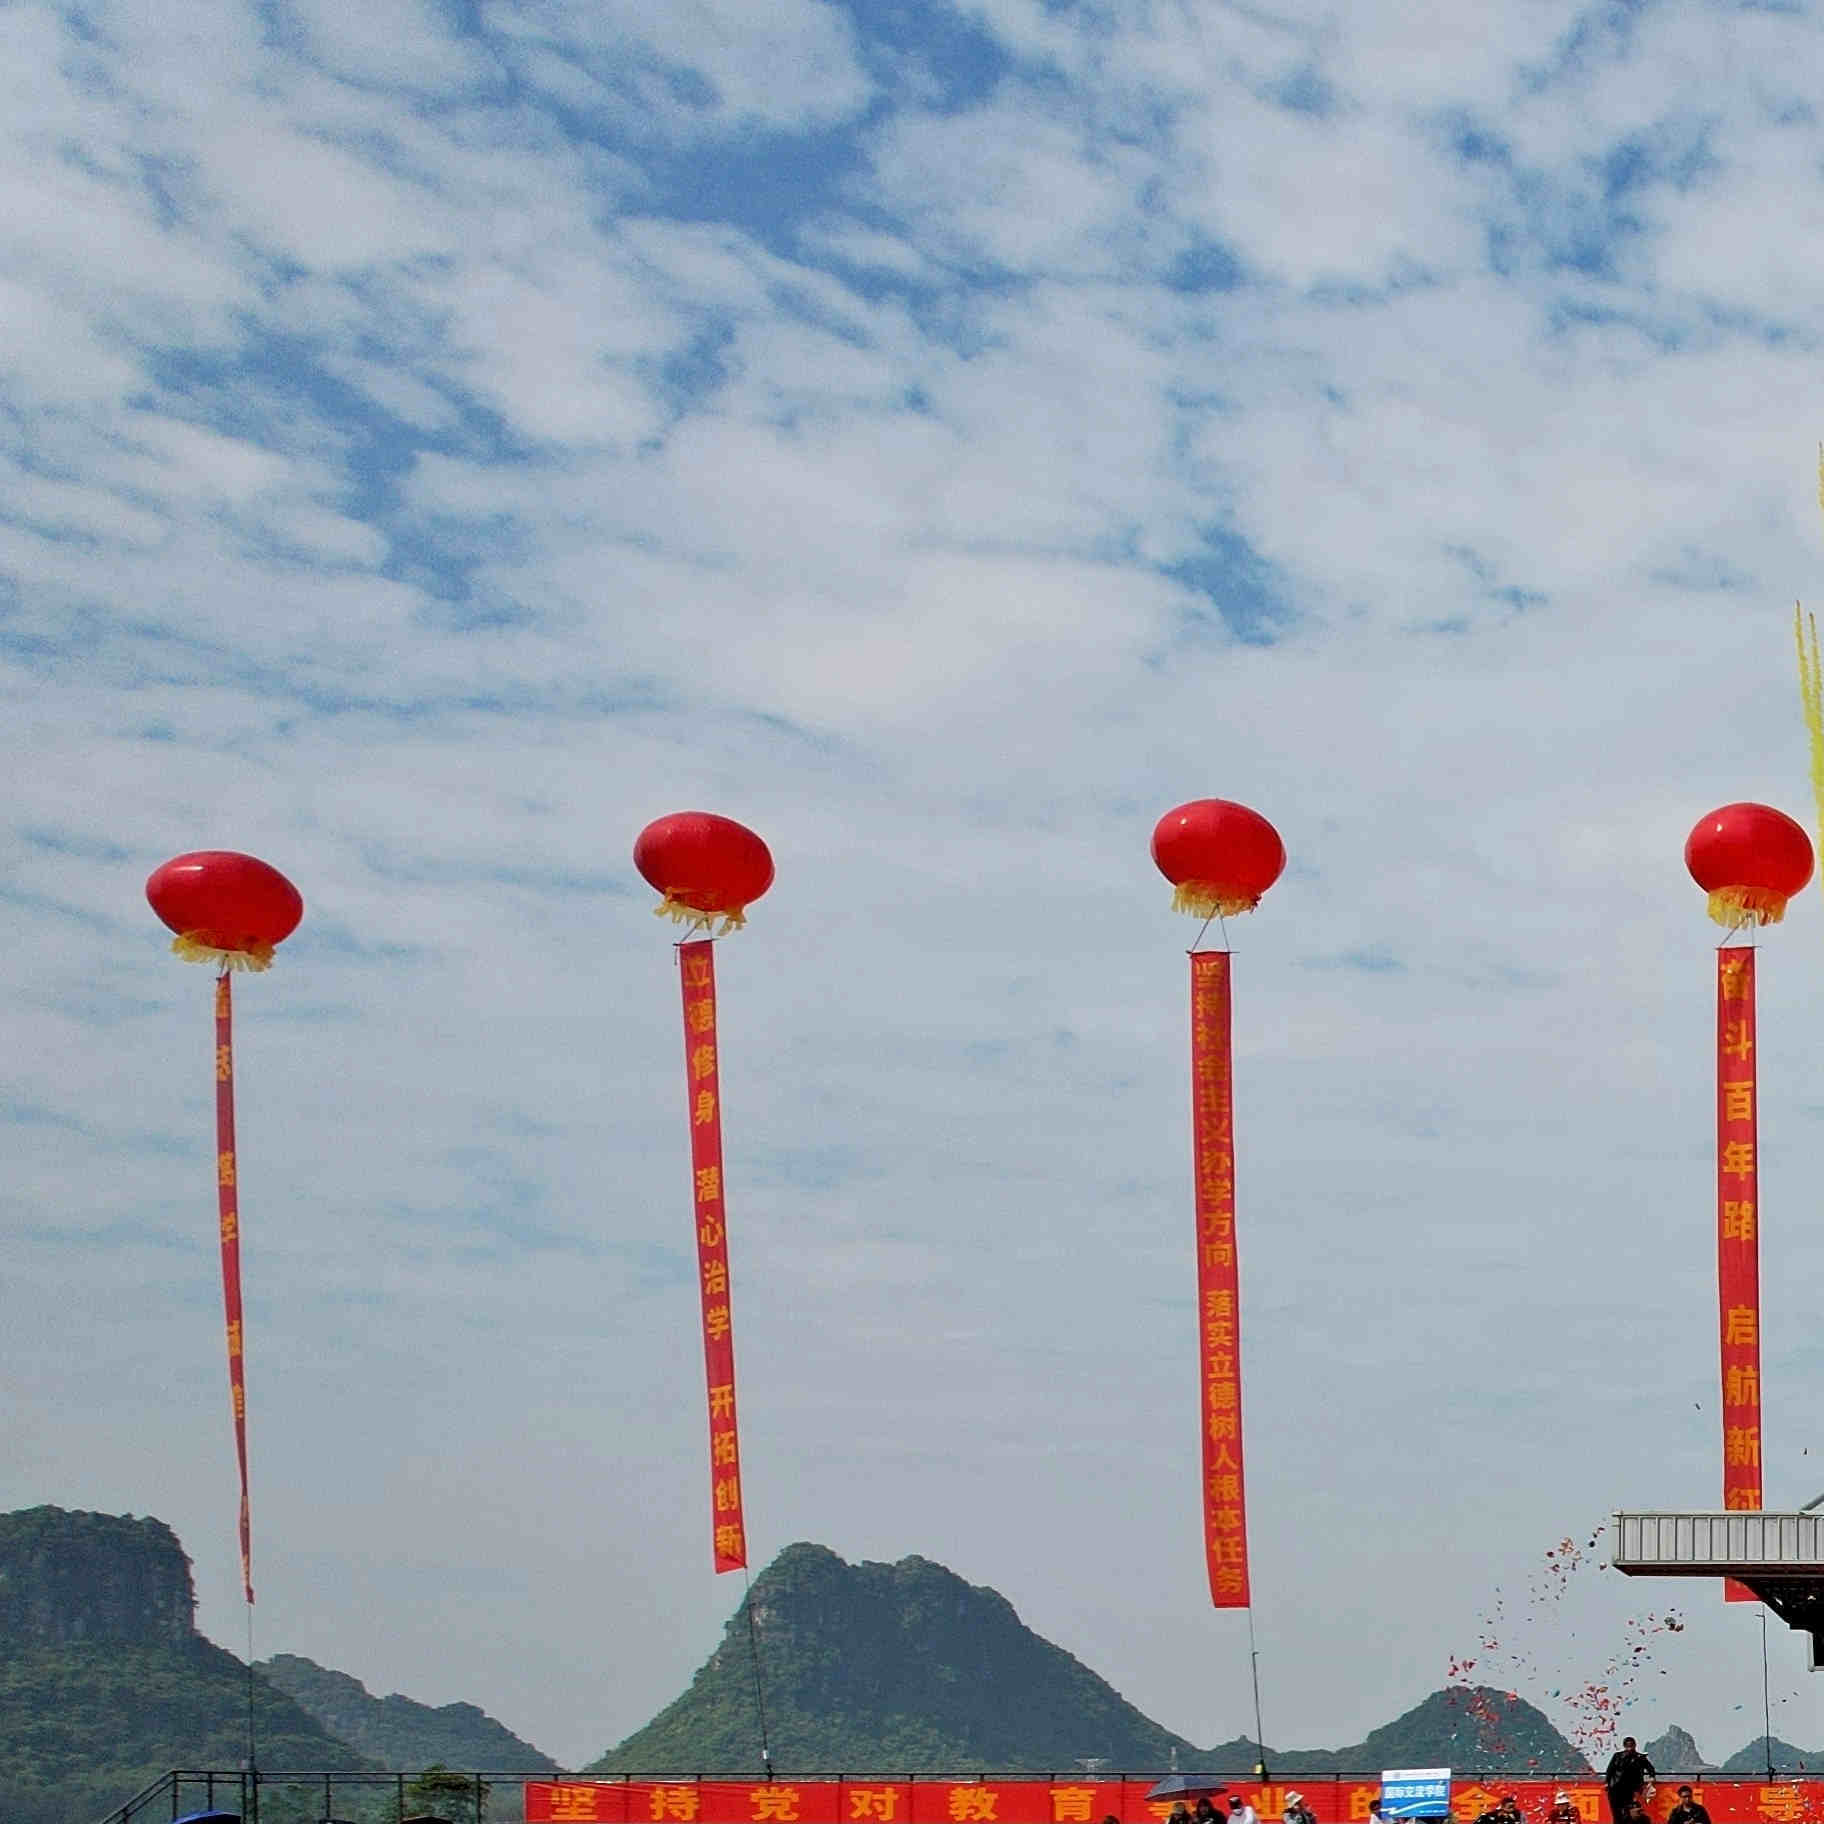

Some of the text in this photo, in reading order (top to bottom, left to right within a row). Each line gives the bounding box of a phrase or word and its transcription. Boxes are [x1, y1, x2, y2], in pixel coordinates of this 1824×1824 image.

[686, 956, 742, 1557] 立德修身 潜心治学 开拓创新
[1720, 958, 1755, 1242] 奋斗百年路
